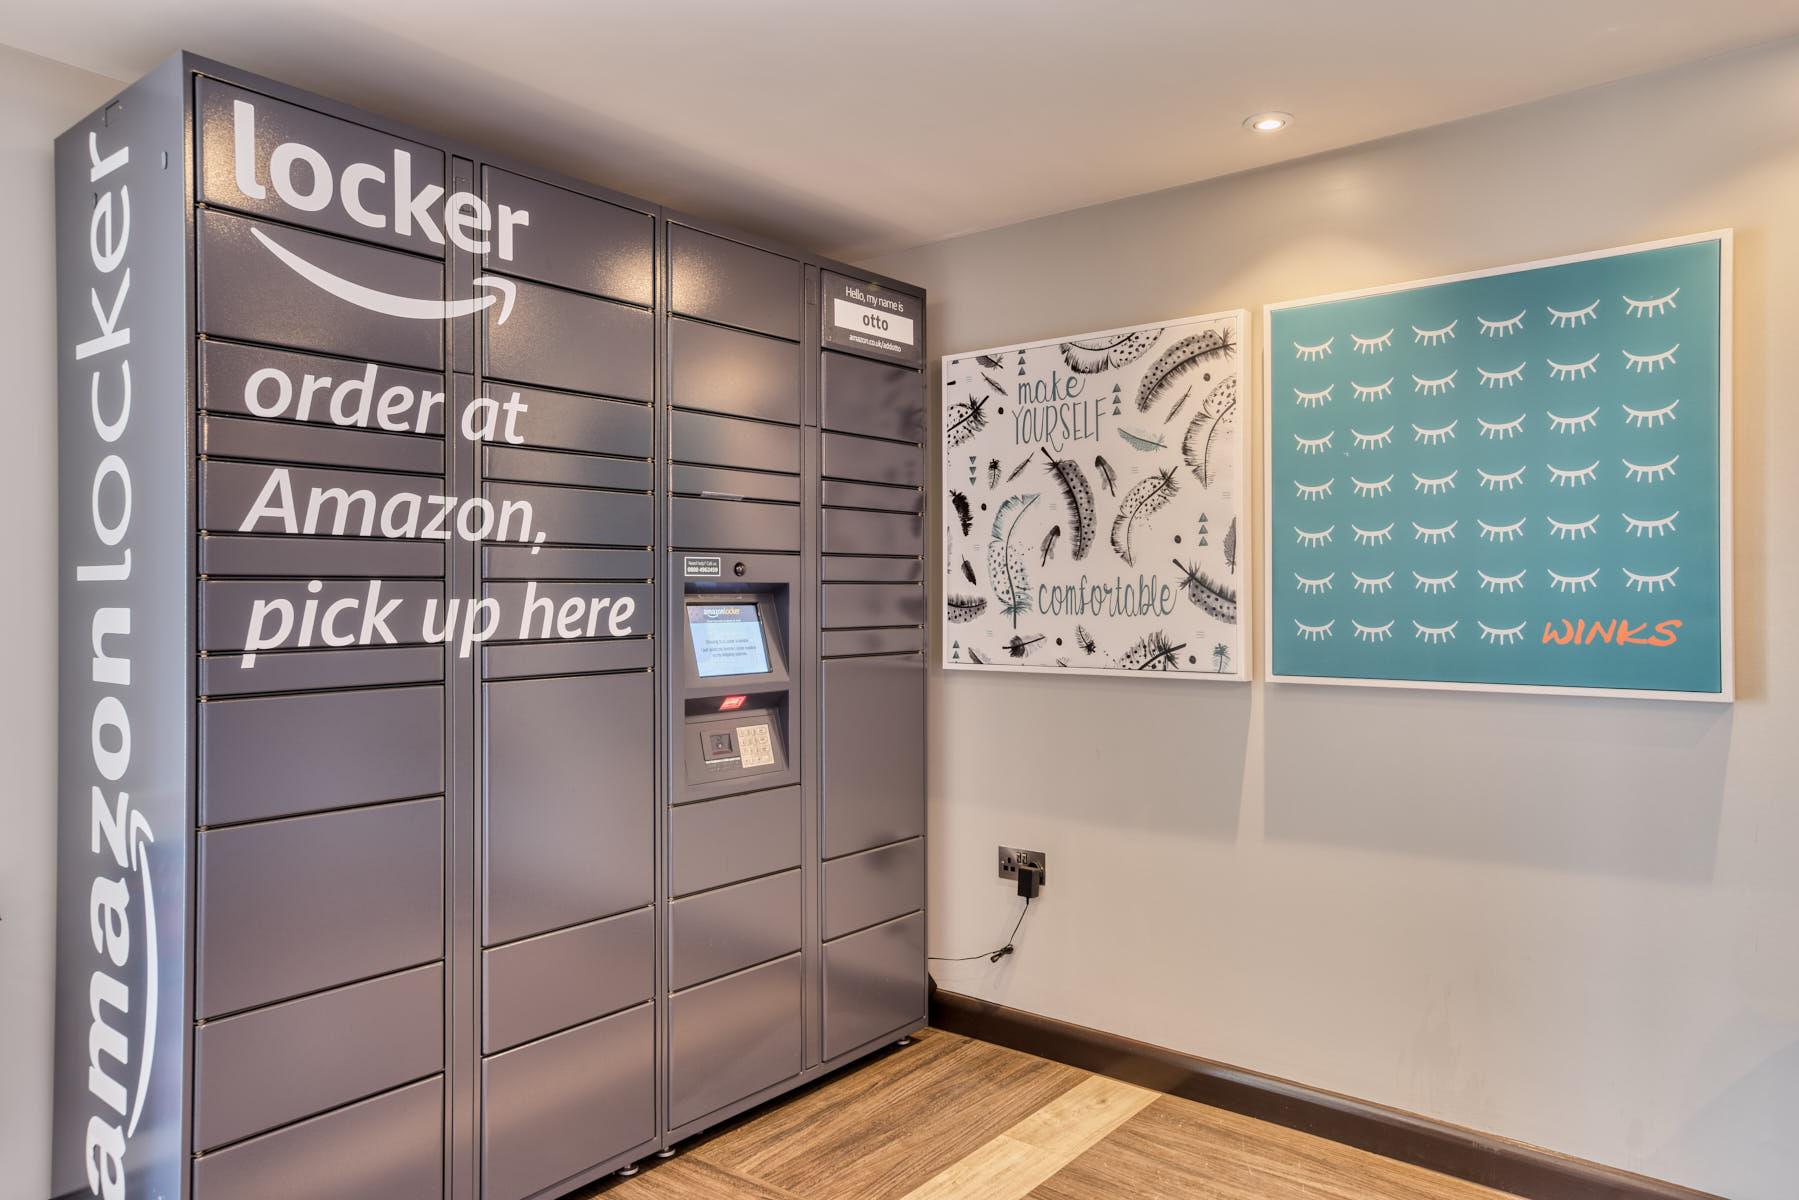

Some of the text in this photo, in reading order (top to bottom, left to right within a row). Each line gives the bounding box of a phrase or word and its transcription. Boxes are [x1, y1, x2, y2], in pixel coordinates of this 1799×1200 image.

[233, 99, 530, 262] locker
[846, 286, 904, 312] Hello, my name is
[862, 314, 889, 331] otto
[244, 363, 529, 445] order at
[1018, 370, 1086, 405] make
[1012, 397, 1107, 453] YOURSELF
[239, 467, 547, 555] Amazon,
[241, 579, 636, 669] pick up here
[1039, 574, 1179, 618] comfortable
[1541, 618, 1683, 647] WINKS
[76, 131, 133, 1200] amazonlocker
